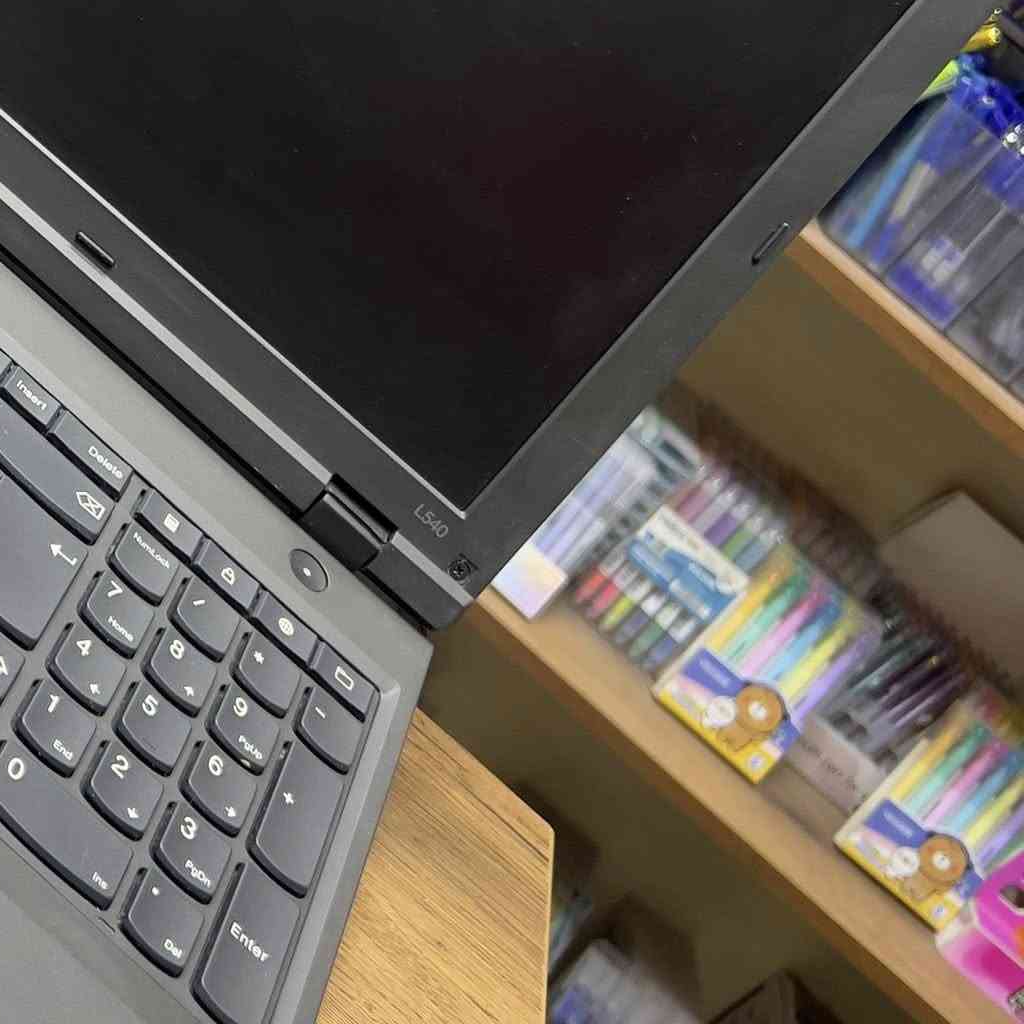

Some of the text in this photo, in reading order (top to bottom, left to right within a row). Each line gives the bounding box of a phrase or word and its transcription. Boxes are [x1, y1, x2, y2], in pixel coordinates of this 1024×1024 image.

[16, 378, 49, 411] Insert
[87, 444, 125, 482] Delete
[413, 501, 452, 538] L540
[133, 529, 173, 569] NumLock
[107, 580, 124, 598] 7
[107, 615, 134, 642] Home
[76, 639, 92, 657] 4
[169, 639, 185, 660] 8
[47, 694, 60, 713] 1
[141, 694, 159, 716] 5
[233, 697, 249, 717] 9
[52, 738, 74, 761] End
[238, 735, 263, 762] PgUp
[7, 757, 25, 780] 0
[110, 754, 130, 779] 2
[208, 754, 224, 776] 6
[180, 816, 198, 840] 3
[92, 871, 108, 890] Ins
[184, 859, 212, 888] PgDn
[163, 938, 183, 959] Del
[230, 921, 269, 962] Enter
